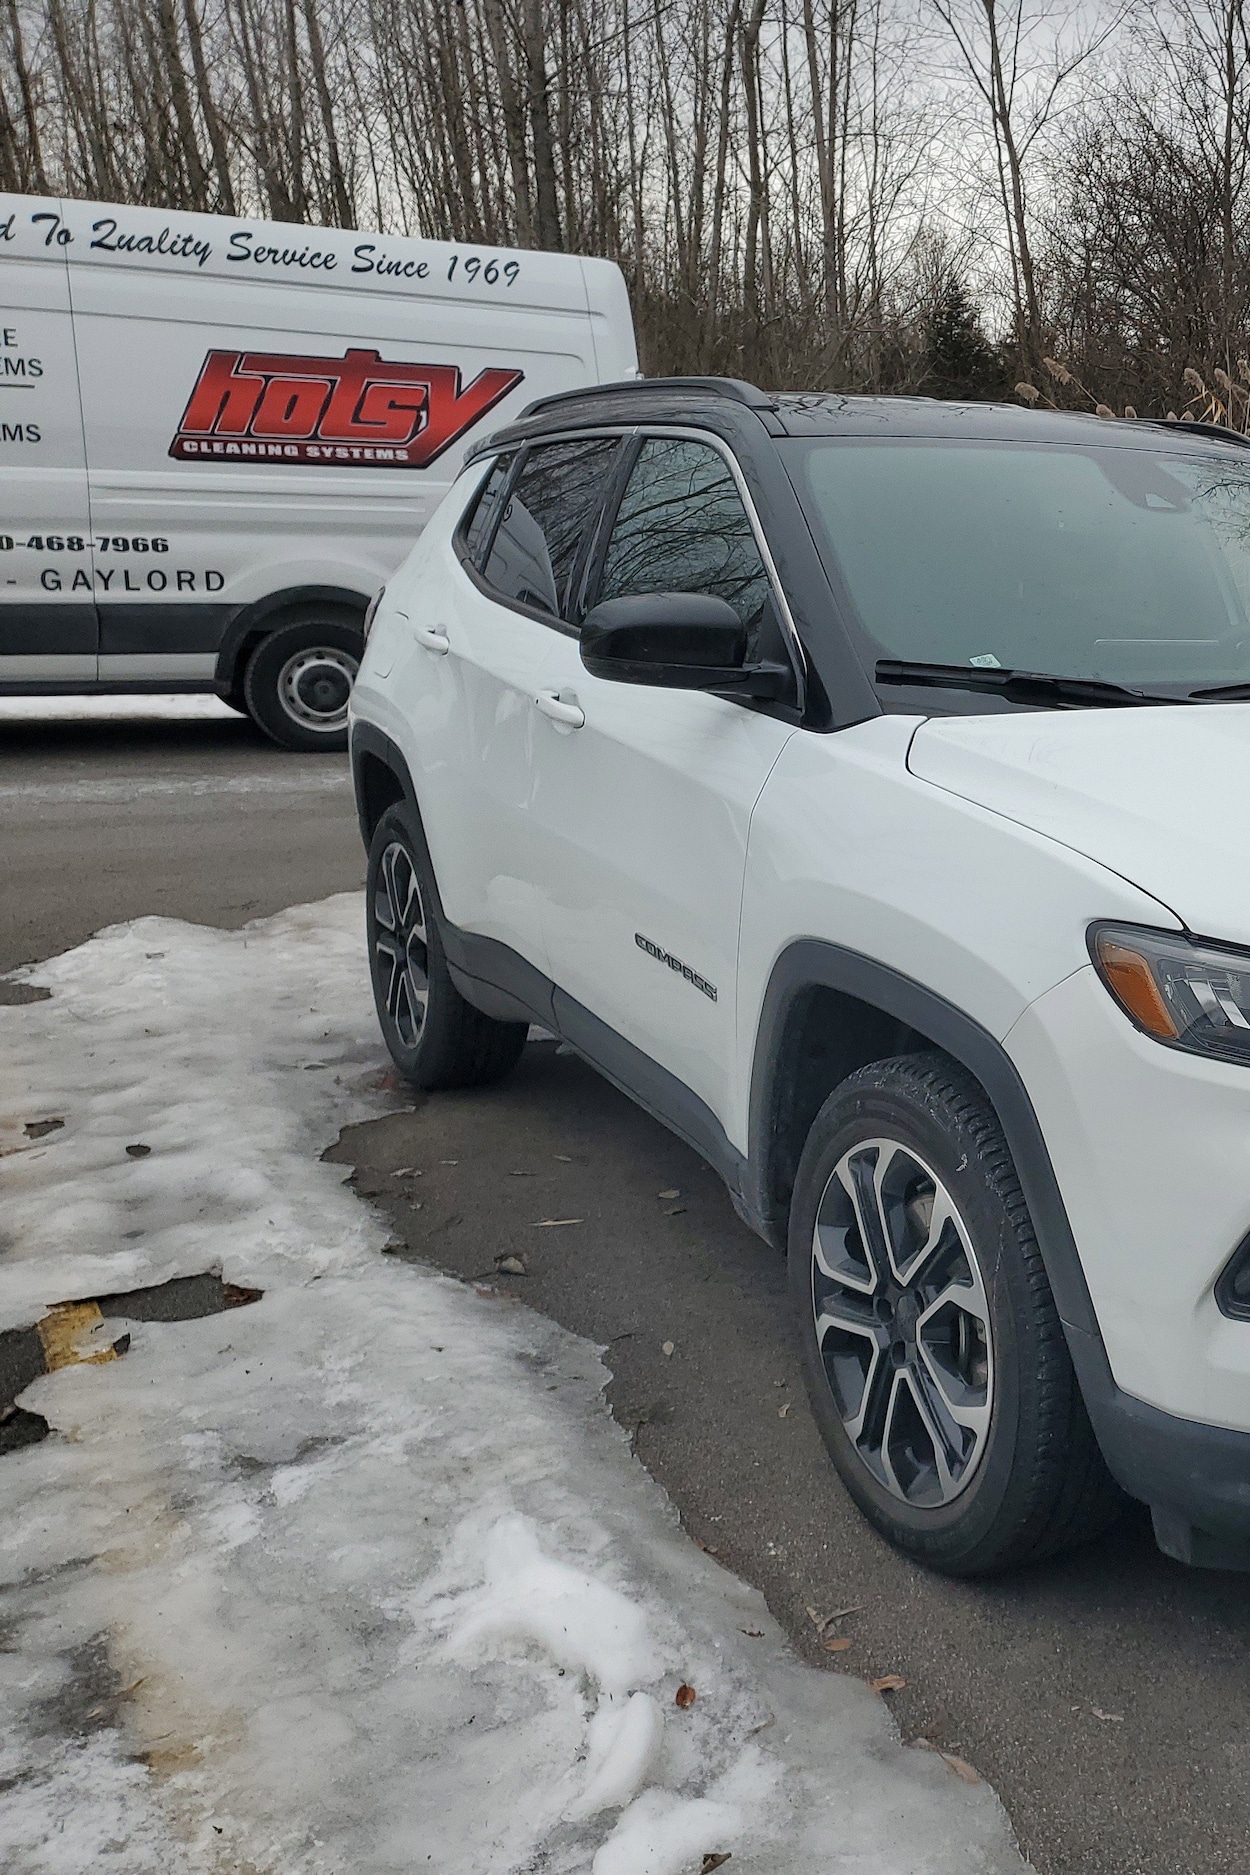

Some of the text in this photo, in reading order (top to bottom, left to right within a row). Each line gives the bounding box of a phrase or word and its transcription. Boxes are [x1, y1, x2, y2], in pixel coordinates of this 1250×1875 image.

[31, 213, 75, 246] To
[90, 219, 213, 267] Quality
[226, 232, 338, 270] Service
[351, 244, 430, 279] Since
[446, 254, 520, 287] 1969
[0, 423, 42, 443] MS
[182, 440, 410, 462] CLEANING SYSTEMS
[40, 568, 226, 592] GAYLORD
[634, 931, 718, 1003] COMPASS
